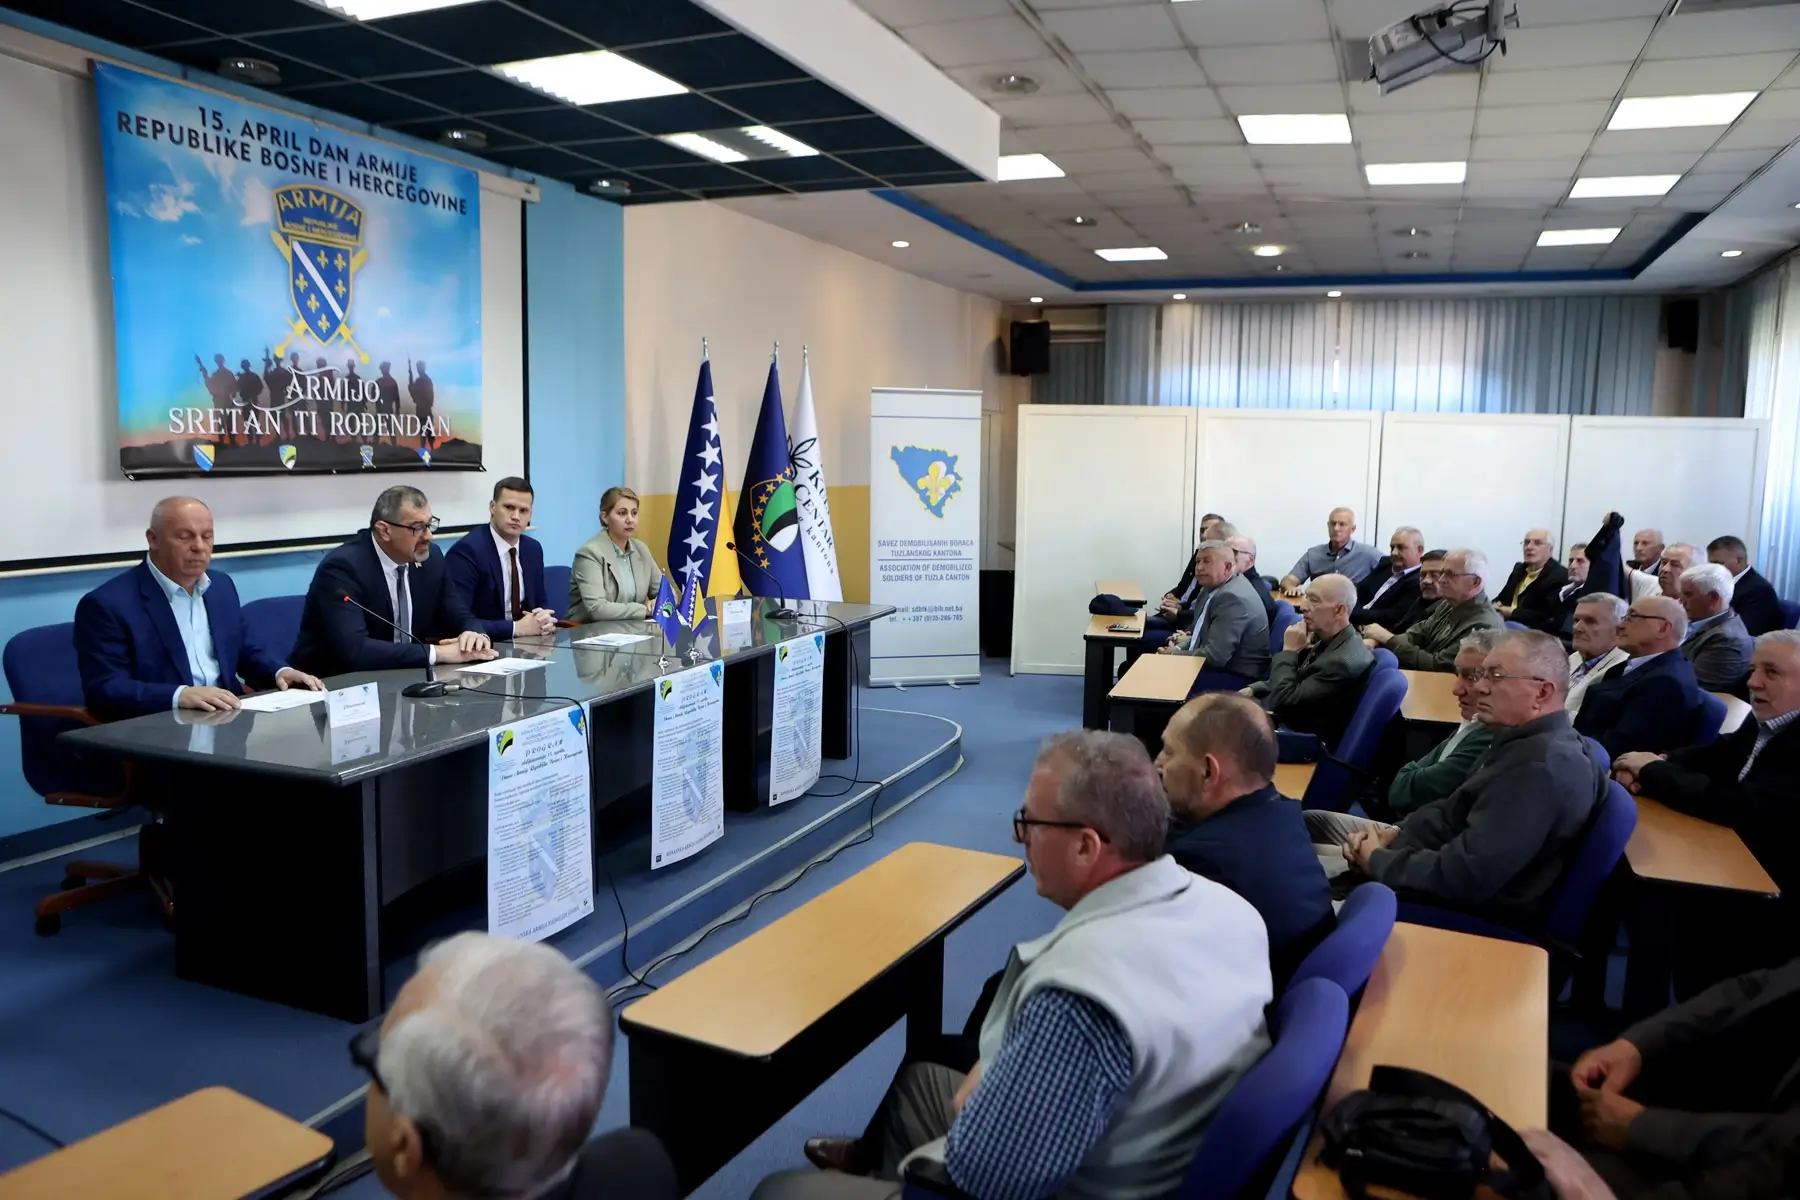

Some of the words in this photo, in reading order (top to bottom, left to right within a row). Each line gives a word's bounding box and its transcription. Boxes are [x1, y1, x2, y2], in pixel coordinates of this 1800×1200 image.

[198, 105, 231, 134] 15.
[240, 119, 302, 152] APRIL
[309, 136, 350, 164] DAN
[356, 151, 417, 183] ARMIJE
[116, 110, 251, 163] REPUBLIKE
[261, 147, 328, 181] BOSNE
[335, 166, 341, 184] I
[348, 169, 467, 215] HERCEGOVINE
[278, 189, 360, 227] ARMIJA
[168, 407, 282, 436] SRETAN
[294, 411, 318, 436] TI
[330, 411, 452, 438] ROĐENDAN
[877, 539, 898, 548] SAVEZ
[899, 539, 949, 548] DEMOBILISANIH
[949, 539, 974, 547] BORACA
[891, 549, 932, 557] TUZLANSKOG
[932, 549, 962, 557] KANTONA
[879, 563, 921, 572] ASSOCIATION
[922, 563, 931, 571] OF
[931, 563, 973, 571] DEMOBILIZED
[882, 574, 913, 582] SOLDIERS
[945, 573, 970, 581] CANTON
